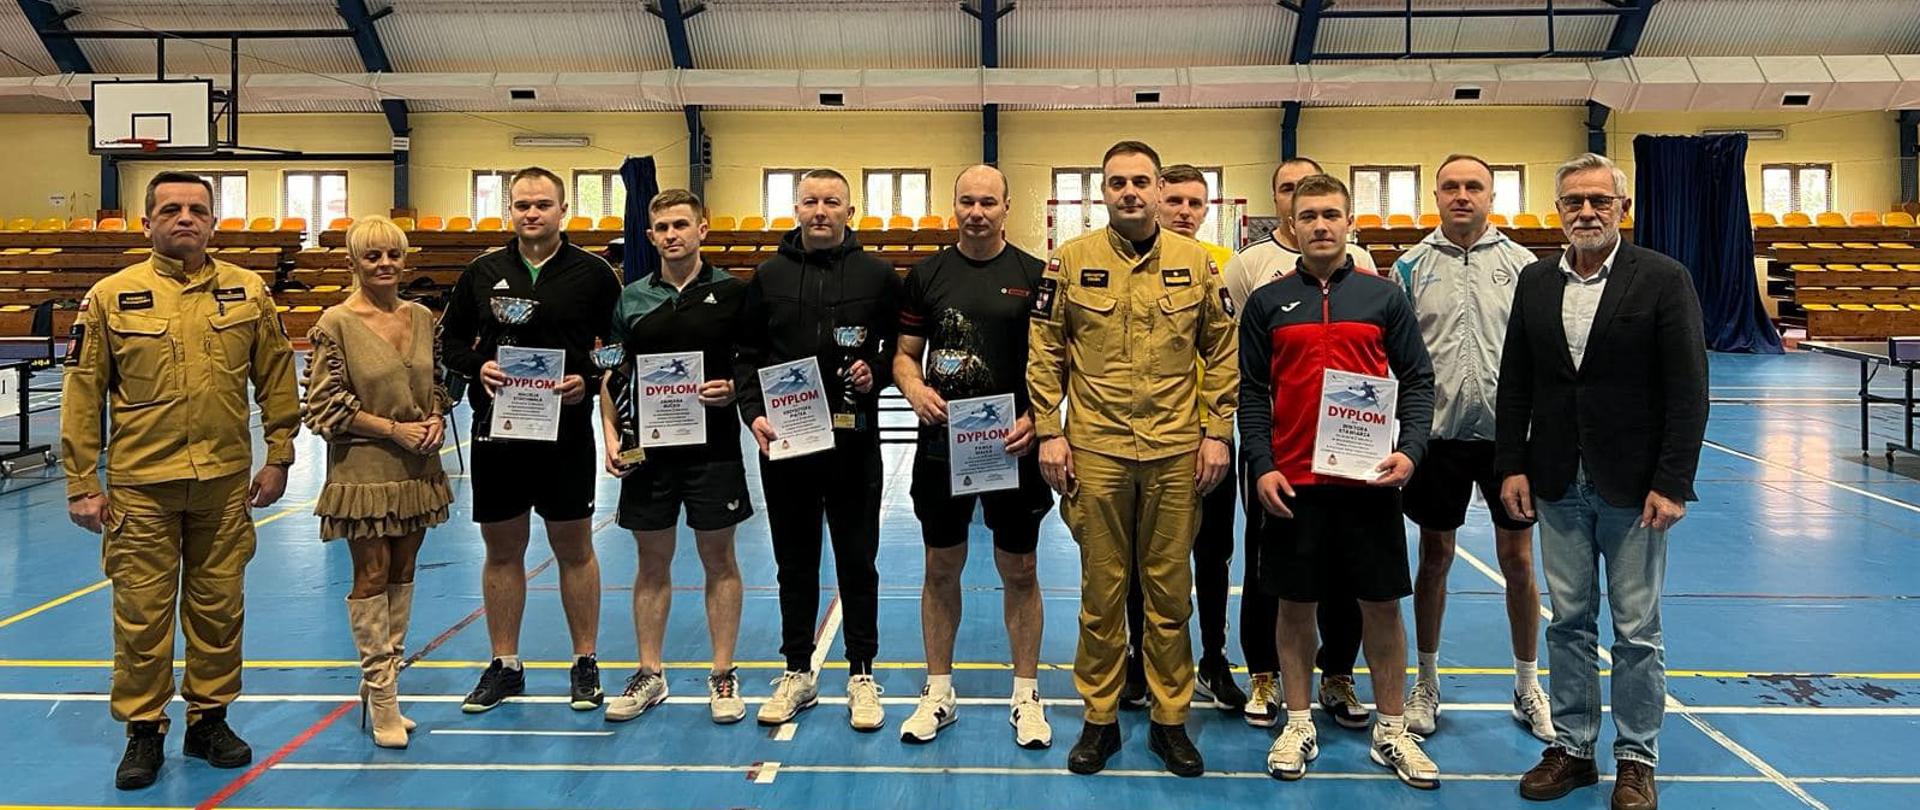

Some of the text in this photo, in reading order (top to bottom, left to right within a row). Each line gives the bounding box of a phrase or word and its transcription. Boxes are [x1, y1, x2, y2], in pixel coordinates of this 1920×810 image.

[504, 377, 555, 389] DYPLOM
[646, 384, 697, 396] DYPLOM
[771, 389, 819, 409] DYPLOM
[1328, 405, 1386, 425] DYPLOM
[957, 428, 1009, 443] DYPLOM
